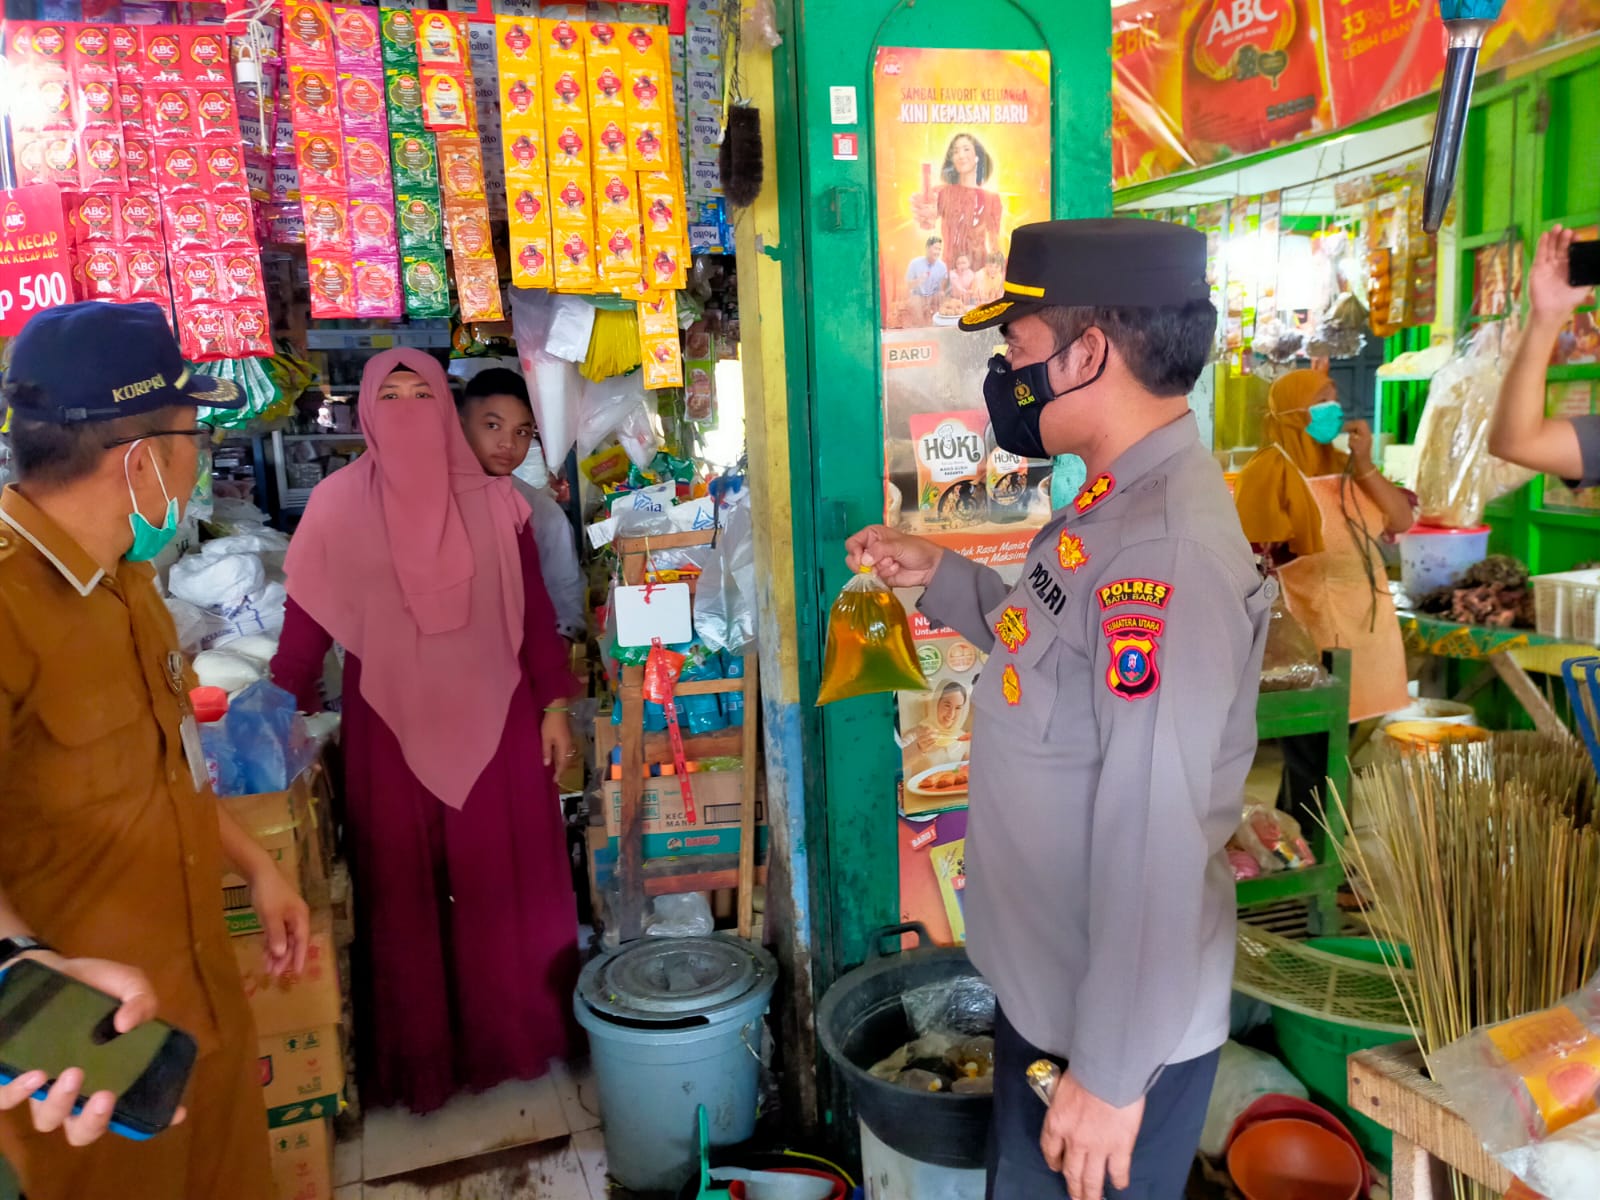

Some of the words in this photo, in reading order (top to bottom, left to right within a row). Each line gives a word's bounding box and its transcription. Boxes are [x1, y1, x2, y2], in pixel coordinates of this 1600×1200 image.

[1207, 0, 1278, 46] ABC
[80, 36, 103, 46] ABC
[471, 42, 489, 50] olto
[152, 45, 174, 55] ABC
[194, 44, 217, 54] ABC
[475, 88, 493, 98] olto
[161, 102, 183, 112] ABC
[203, 101, 226, 111] ABC
[901, 104, 928, 122] KINI
[932, 104, 990, 124] KEMASAN
[995, 104, 1028, 123] BARU
[694, 125, 718, 136] Molto
[480, 136, 497, 144] olto
[170, 158, 192, 168] ABC
[212, 158, 234, 168] ABC
[696, 170, 719, 180] Molto
[84, 206, 106, 216] ABC
[127, 206, 149, 216] ABC
[6, 214, 24, 226] ABC
[178, 214, 201, 224] ABC
[220, 213, 243, 223] ABC
[693, 230, 717, 240] Molto
[18, 232, 58, 250] KECAP
[13, 252, 41, 264] KECAP
[90, 262, 112, 272] ABC
[132, 262, 154, 272] ABC
[230, 267, 250, 277] ABC
[188, 270, 209, 280] ABC
[19, 272, 66, 310] 500
[197, 322, 218, 333] ABC
[238, 320, 259, 331] ABC
[889, 348, 931, 361] BARU
[112, 373, 166, 402] KORPRI
[924, 434, 981, 463] HOKI
[1028, 562, 1067, 616] POLRI
[1102, 581, 1166, 599] POLRES
[1105, 594, 1128, 606] BATU
[1132, 593, 1160, 605] BARA
[1107, 618, 1137, 632] SUMATERA
[1138, 618, 1160, 632] UTARA
